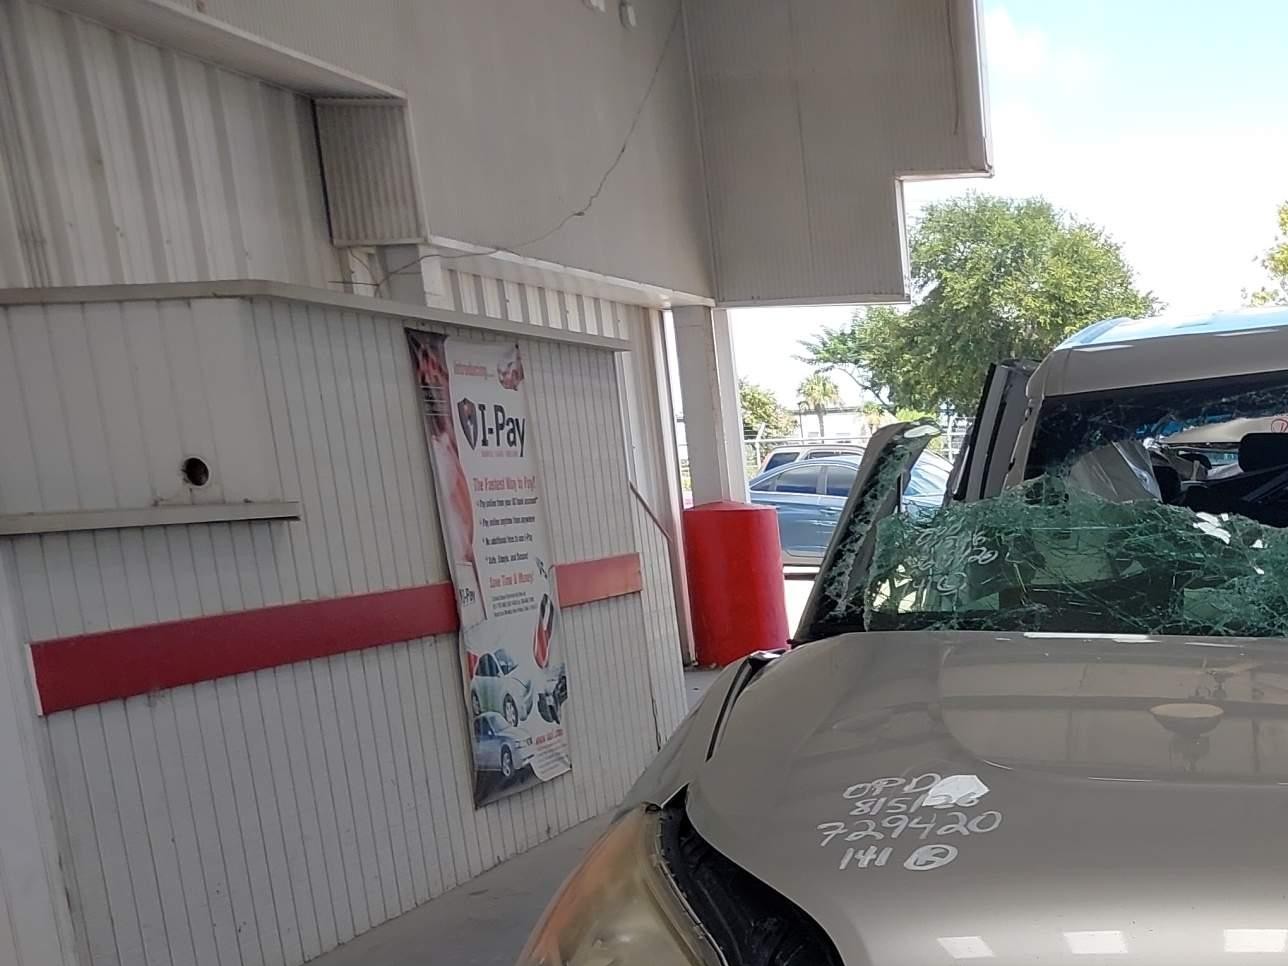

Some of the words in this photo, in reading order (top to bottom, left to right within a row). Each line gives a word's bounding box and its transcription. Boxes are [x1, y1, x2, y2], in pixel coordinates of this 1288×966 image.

[478, 403, 526, 458] I-Pay
[816, 810, 1003, 847] 729420
[839, 846, 893, 870] 141
